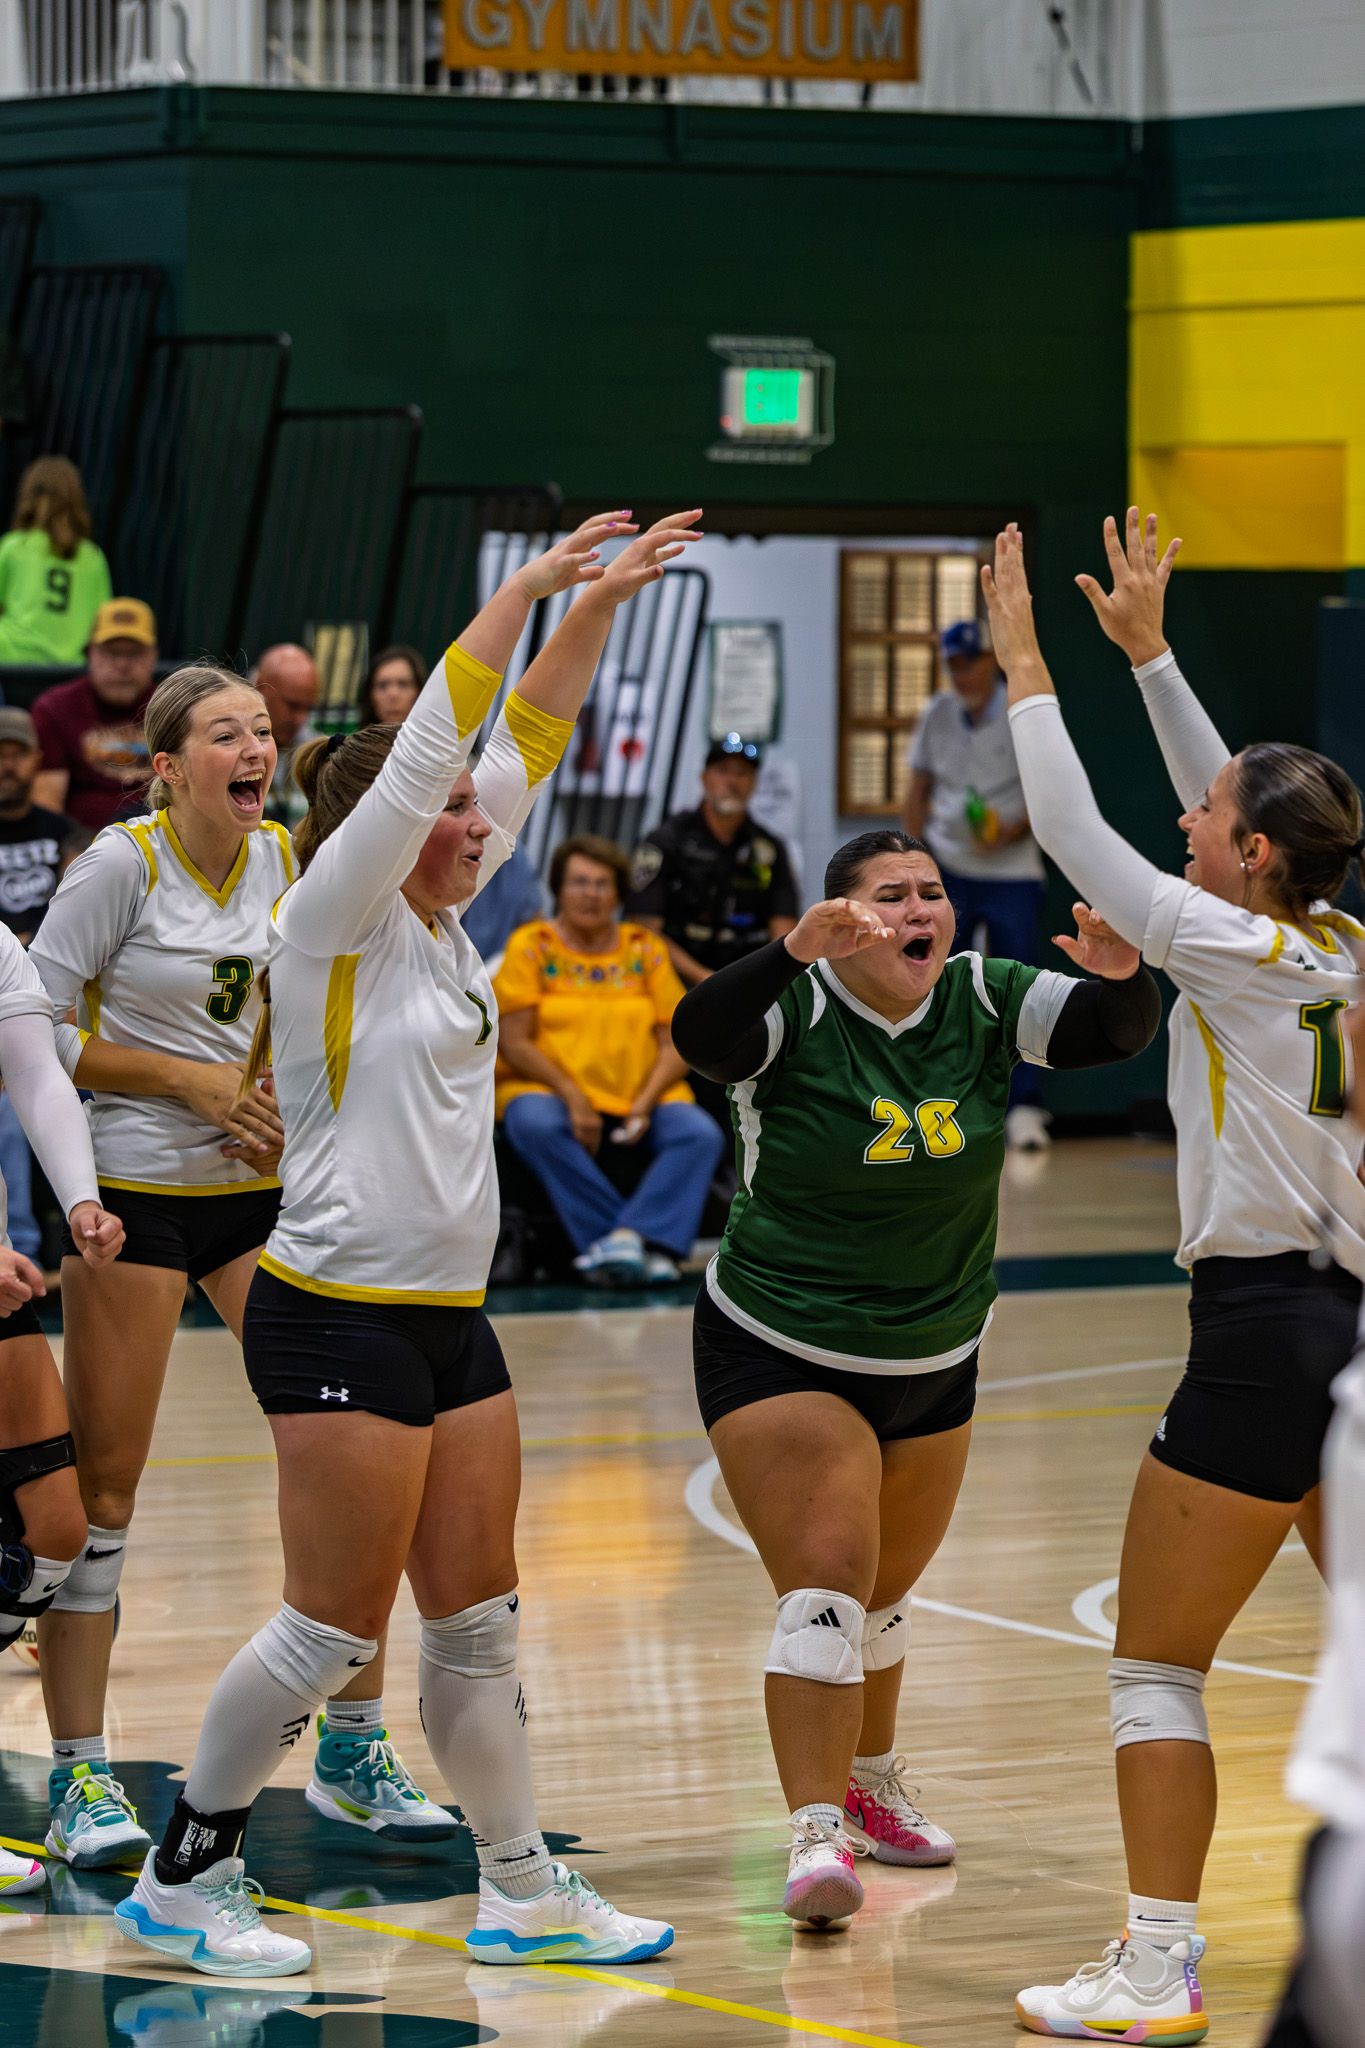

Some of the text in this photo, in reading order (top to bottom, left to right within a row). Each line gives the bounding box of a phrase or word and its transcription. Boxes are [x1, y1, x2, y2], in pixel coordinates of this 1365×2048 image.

[463, 0, 903, 62] GYMNASIUM
[46, 567, 71, 614] 9
[206, 955, 254, 1025] 3
